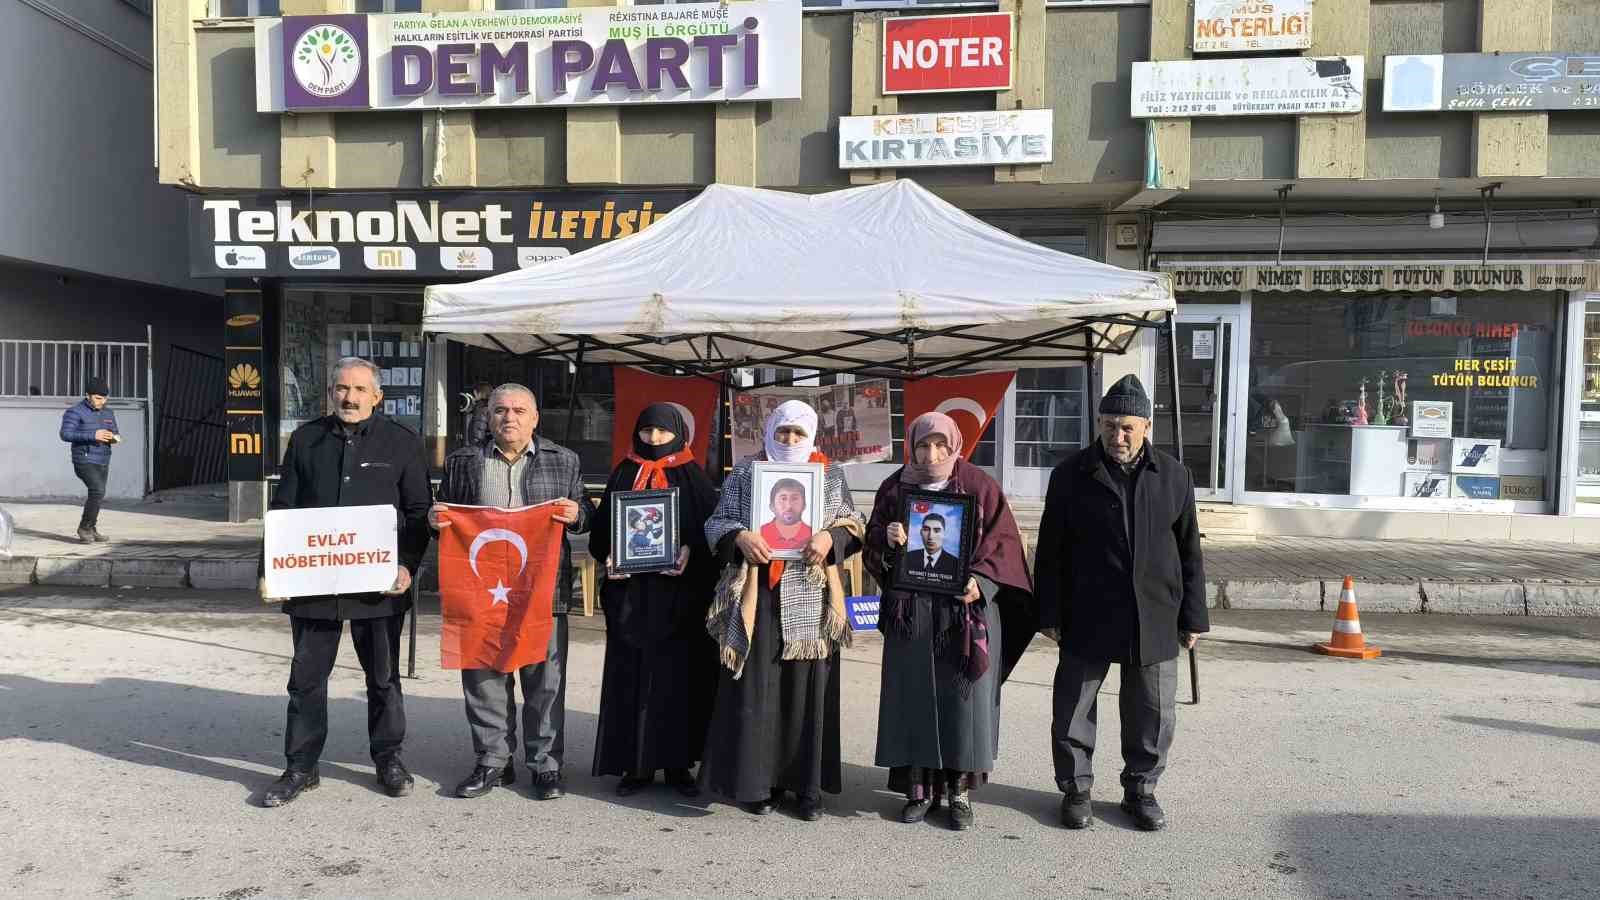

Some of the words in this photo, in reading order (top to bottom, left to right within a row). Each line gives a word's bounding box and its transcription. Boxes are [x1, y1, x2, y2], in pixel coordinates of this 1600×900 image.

[430, 19, 459, 29] GELAN
[609, 27, 641, 40] MUŞ
[647, 23, 660, 37] İL
[664, 23, 729, 36] ÖRGÜTÜ
[394, 33, 444, 42] HALKLARIN
[446, 31, 479, 42] EŞİTLİK
[481, 31, 493, 40] VE
[494, 28, 545, 40] DEMOKRASİ
[548, 26, 583, 38] PARTİSİ
[392, 41, 530, 96] DEM
[552, 16, 759, 95] PARTİ
[892, 37, 1003, 70] NOTER
[308, 82, 324, 94] DEM
[1170, 89, 1231, 101] YAYINCILIK
[1234, 92, 1249, 100] ve
[1252, 88, 1328, 100] REKLAMCILIK
[1172, 104, 1189, 113] 212
[845, 133, 1047, 161] KIRTASİYE
[203, 200, 514, 243] TeknoNet
[1175, 266, 1242, 286] TÜTÜNCÜ
[1393, 266, 1444, 286] TÜTÜN
[1453, 269, 1524, 286] BULUNUR
[1455, 359, 1480, 372] HER
[1484, 356, 1518, 373] ÇEŞİT
[1432, 372, 1473, 387] TÜTÜN
[1478, 375, 1537, 388] BULUNUR
[307, 532, 357, 548] EVLAT
[272, 548, 392, 570] NÖBETİNDEYİZ
